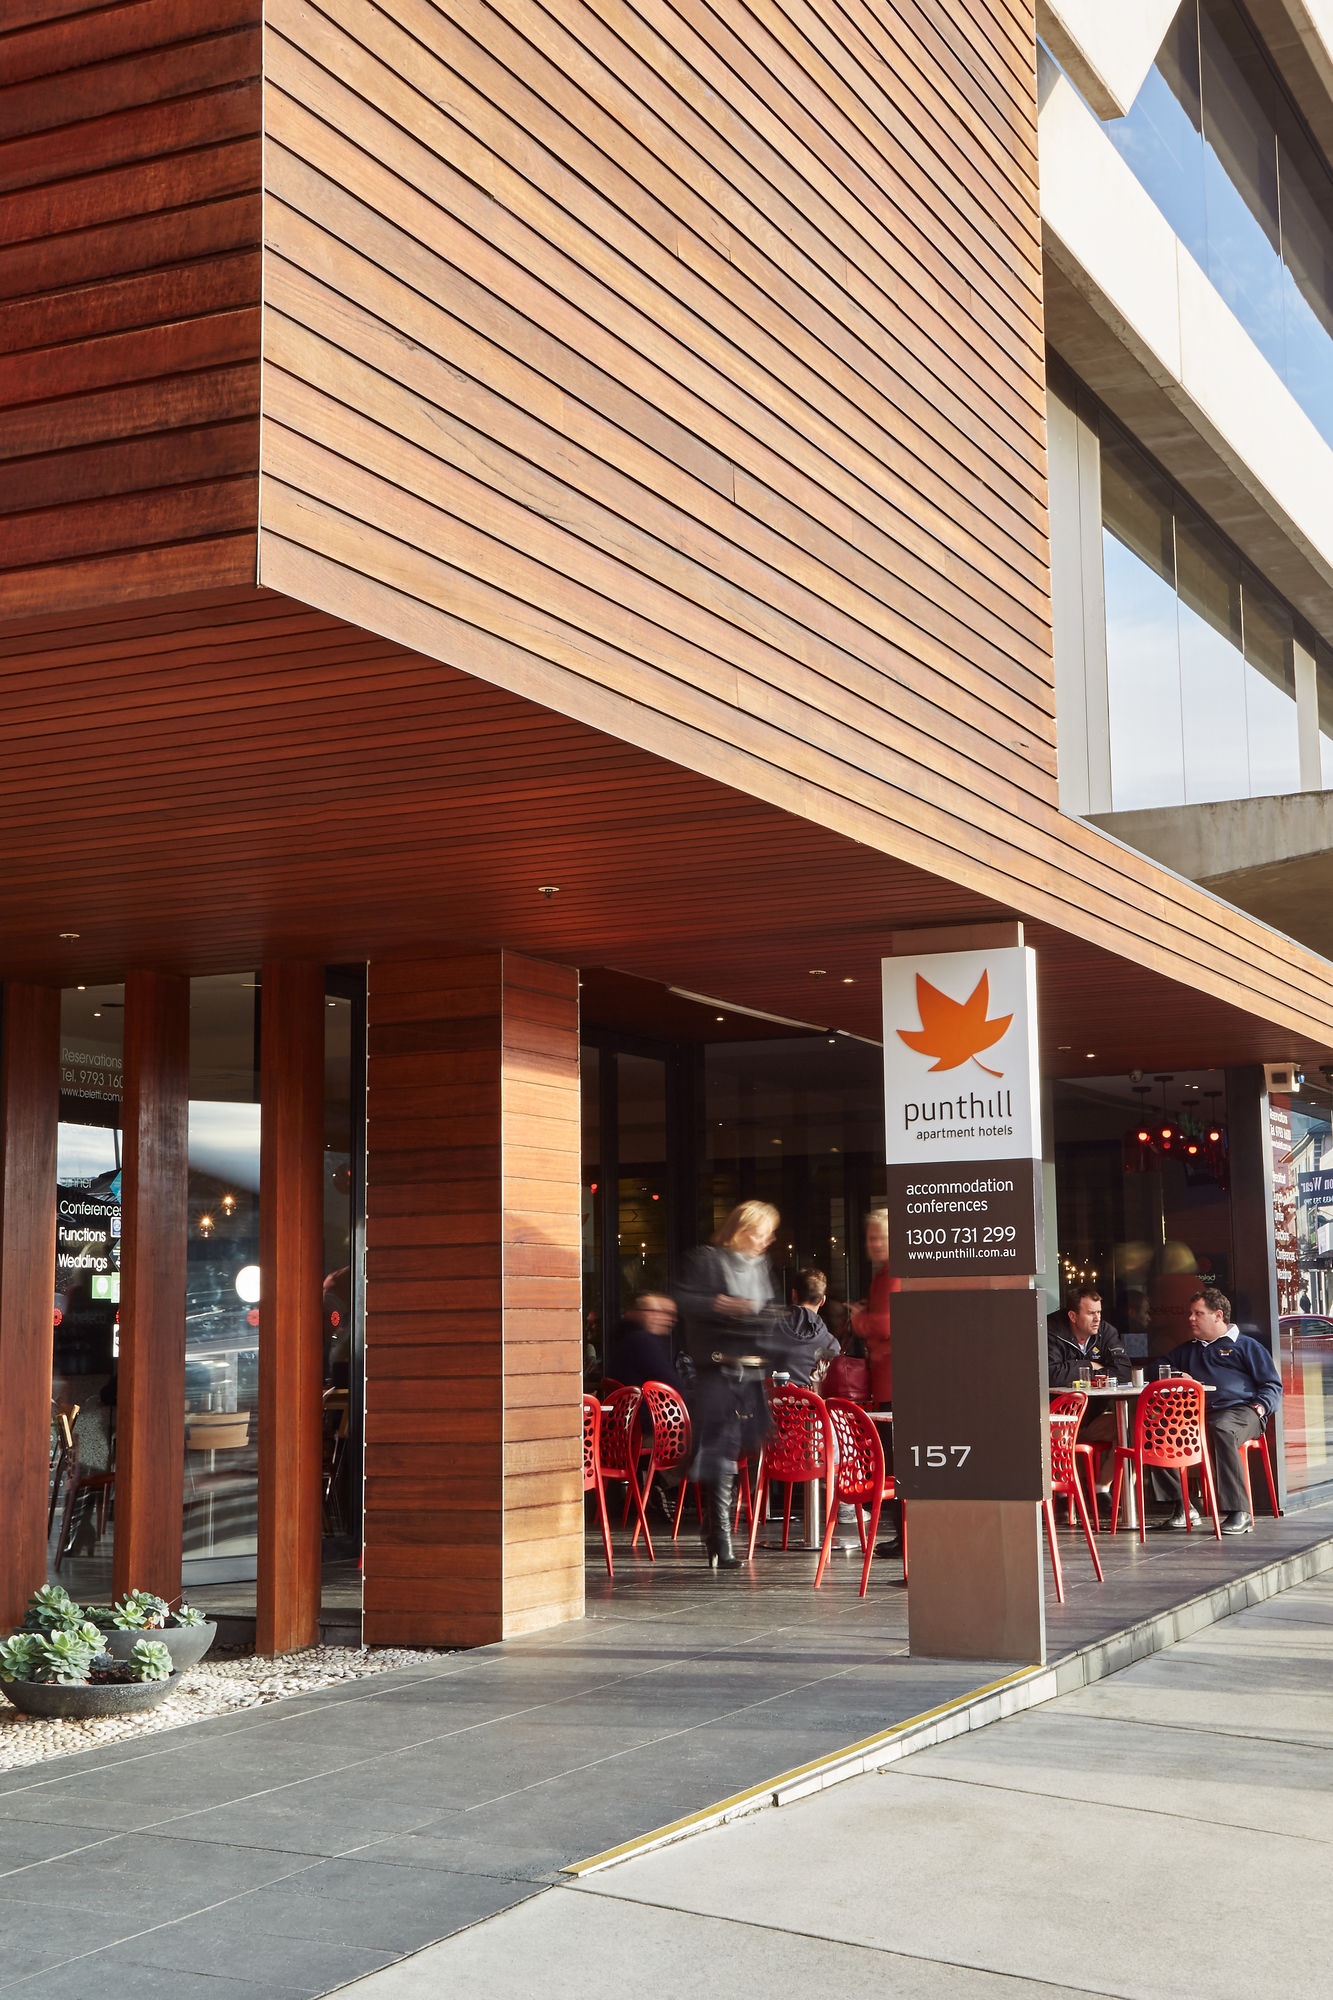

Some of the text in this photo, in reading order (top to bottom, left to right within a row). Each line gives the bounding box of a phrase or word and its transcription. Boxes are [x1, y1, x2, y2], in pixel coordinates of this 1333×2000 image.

[62, 1047, 122, 1069] Reservations
[61, 1067, 123, 1089] Tel. 9793 160
[904, 1090, 1012, 1130] punthill
[916, 1124, 1013, 1141] apartment hotels
[906, 1178, 1014, 1195] accommodation
[906, 1199, 988, 1214] conferences
[59, 1226, 106, 1242] Functions
[906, 1226, 1016, 1245] 1300 731 299
[58, 1253, 108, 1272] Weddings
[908, 1247, 1016, 1261] www.punthill.com.au
[910, 1445, 972, 1468] 157
